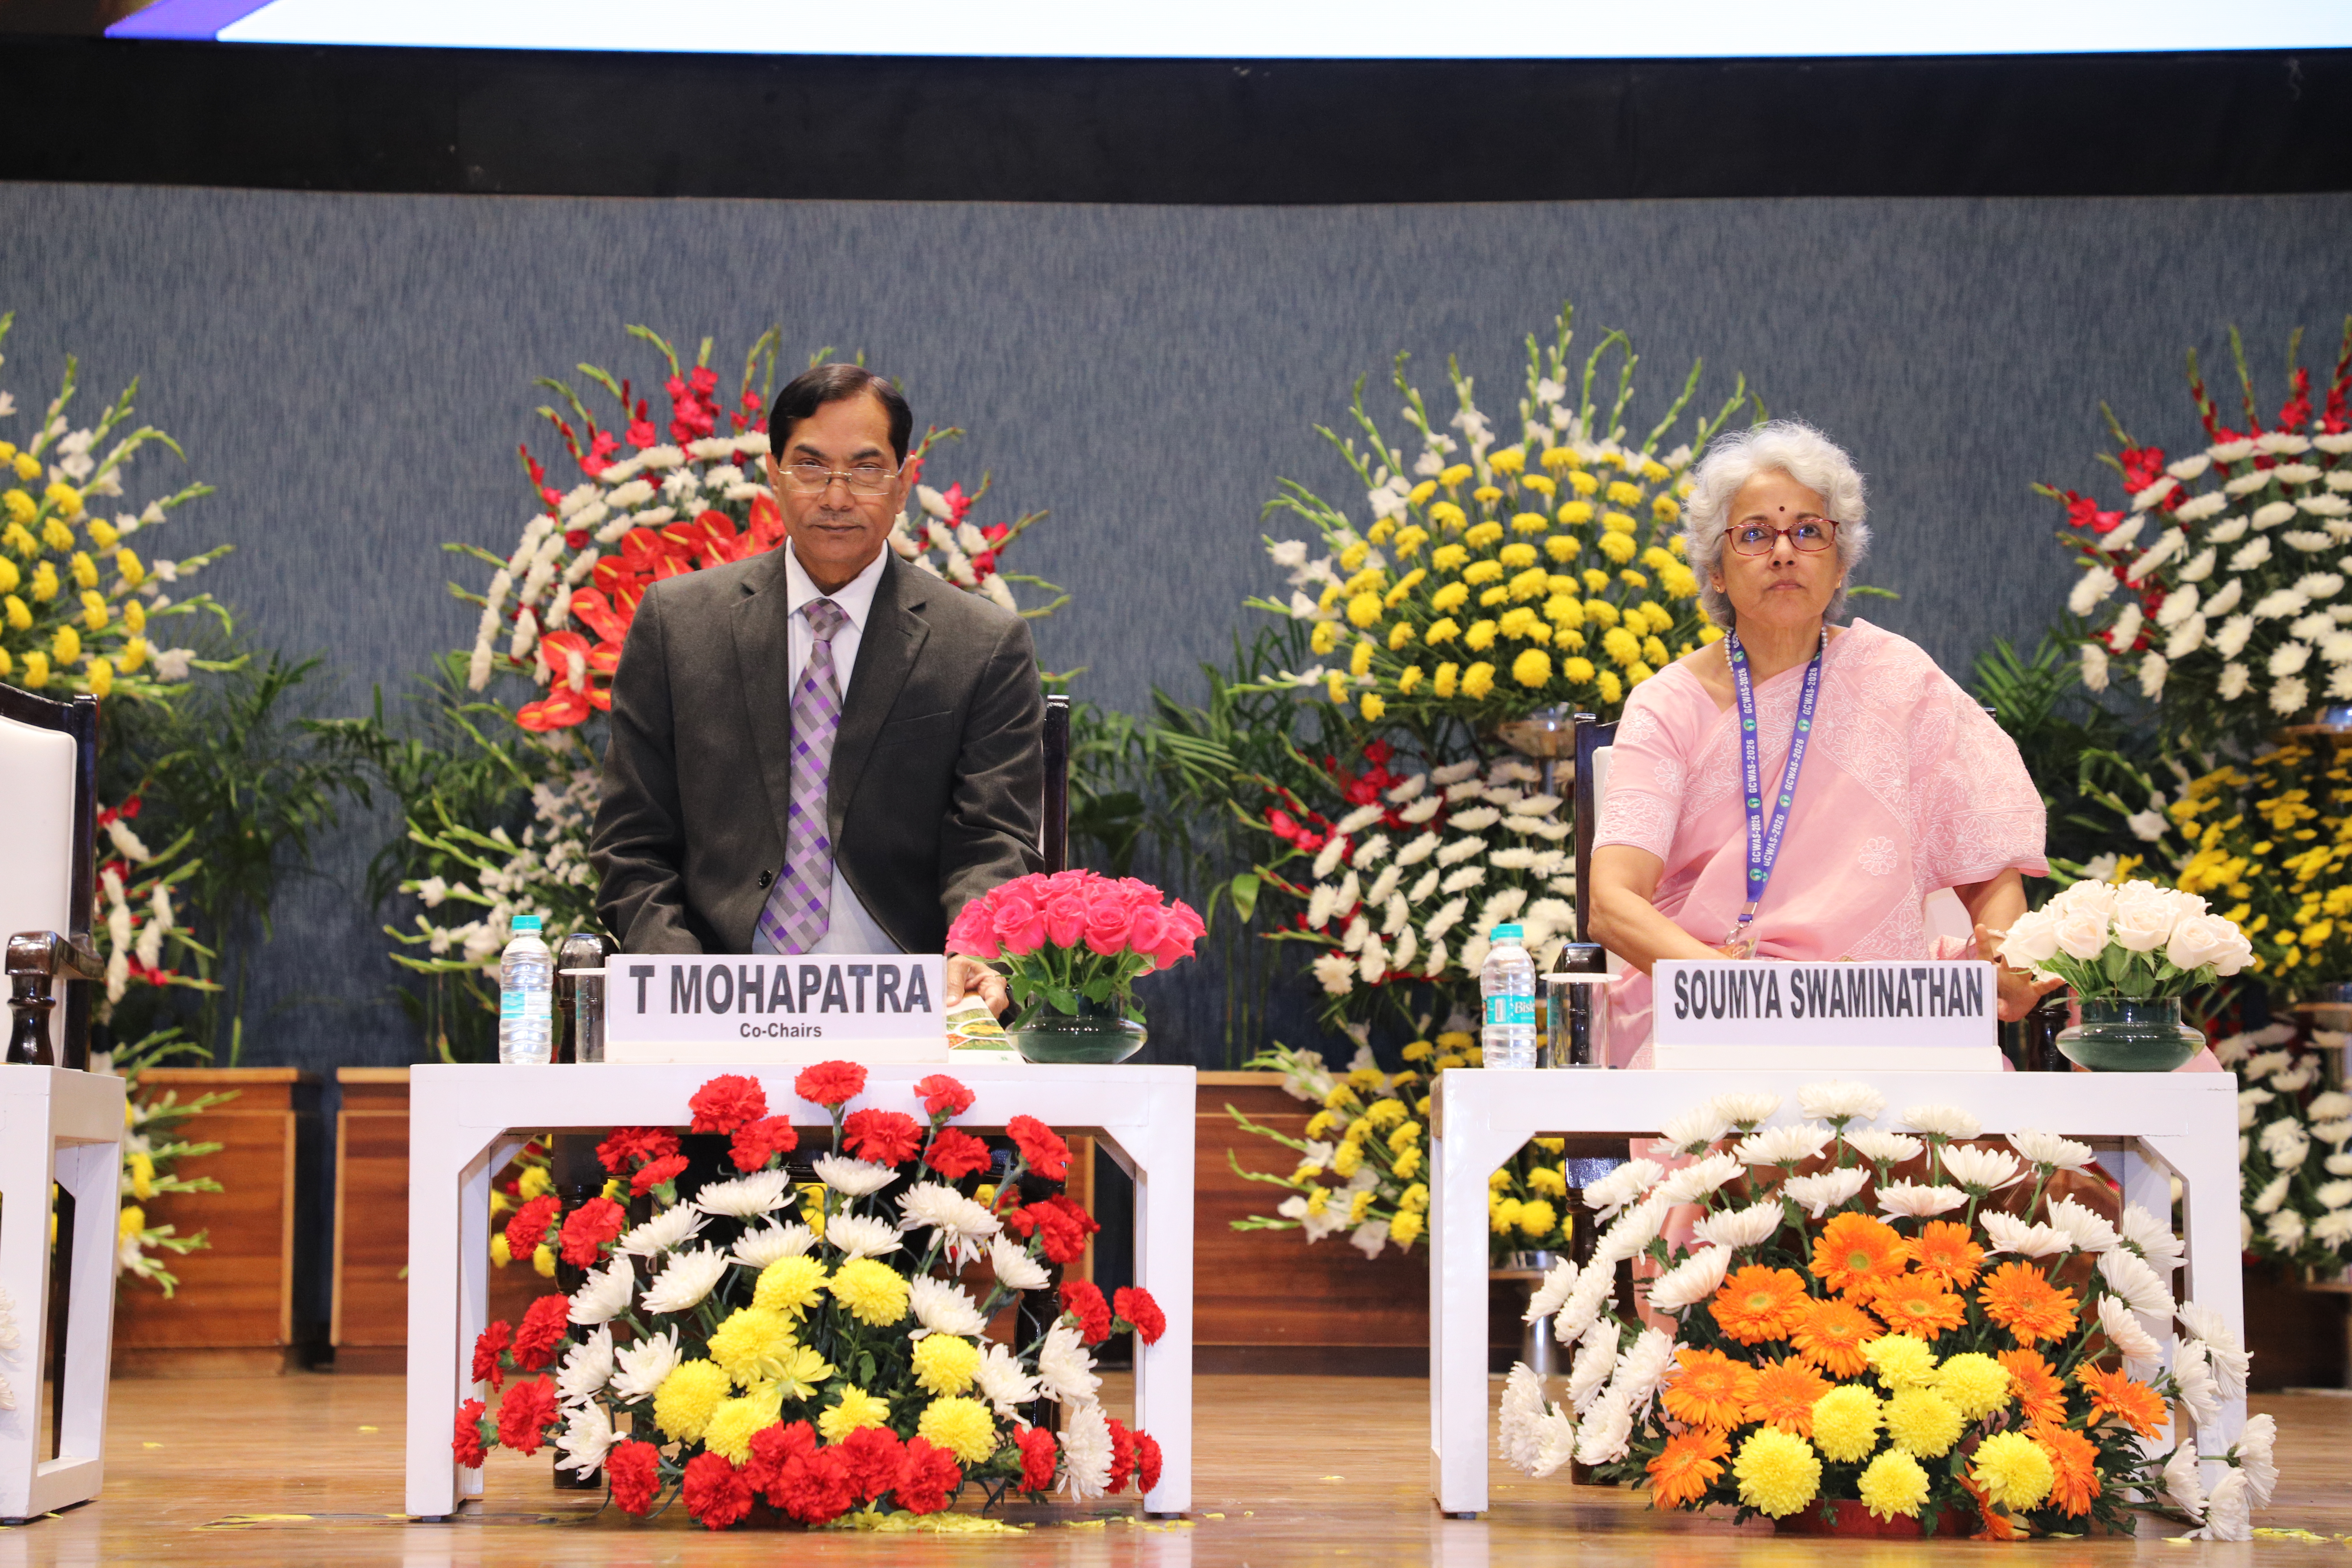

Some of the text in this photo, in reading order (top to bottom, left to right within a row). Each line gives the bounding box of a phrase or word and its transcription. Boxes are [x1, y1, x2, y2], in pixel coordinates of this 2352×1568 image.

[1738, 667, 1753, 714] GCWAS-2026
[1802, 667, 1818, 715] GCWAS-2026
[1746, 739, 1758, 793] GCWAS-2026
[1784, 738, 1805, 791] GCWAS-2026
[1751, 815, 1761, 863] GCWAS-2026
[1763, 813, 1785, 867] GCWAS-2026
[630, 965, 931, 1014] T MOHAPATRA
[1675, 968, 1983, 1020] SOUMYA SWAMINATHAN
[740, 1023, 821, 1038] Co-Chairs
